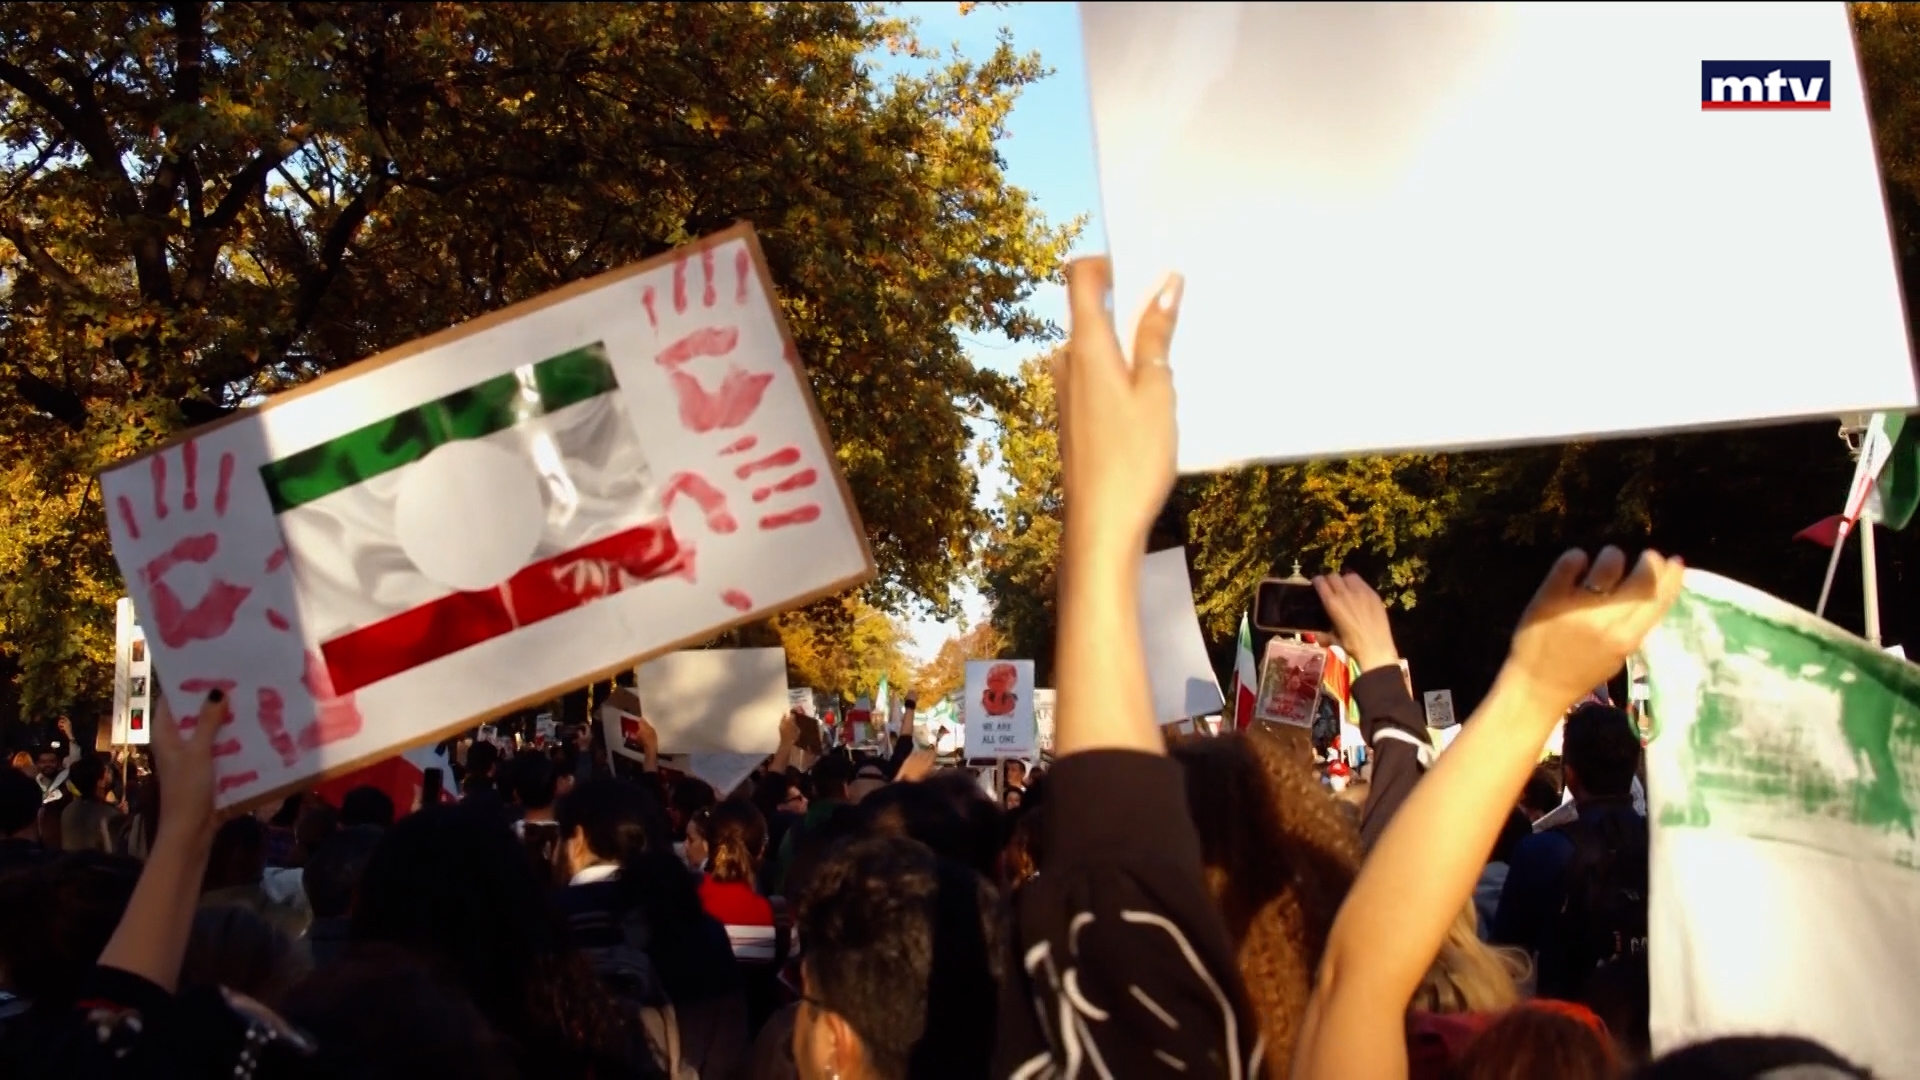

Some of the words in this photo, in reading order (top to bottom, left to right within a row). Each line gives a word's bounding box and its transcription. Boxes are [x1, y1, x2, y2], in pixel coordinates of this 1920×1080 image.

[982, 723, 993, 732] WE
[997, 723, 1012, 732] ARE
[982, 735, 995, 744] ALL
[999, 735, 1016, 744] ONE
